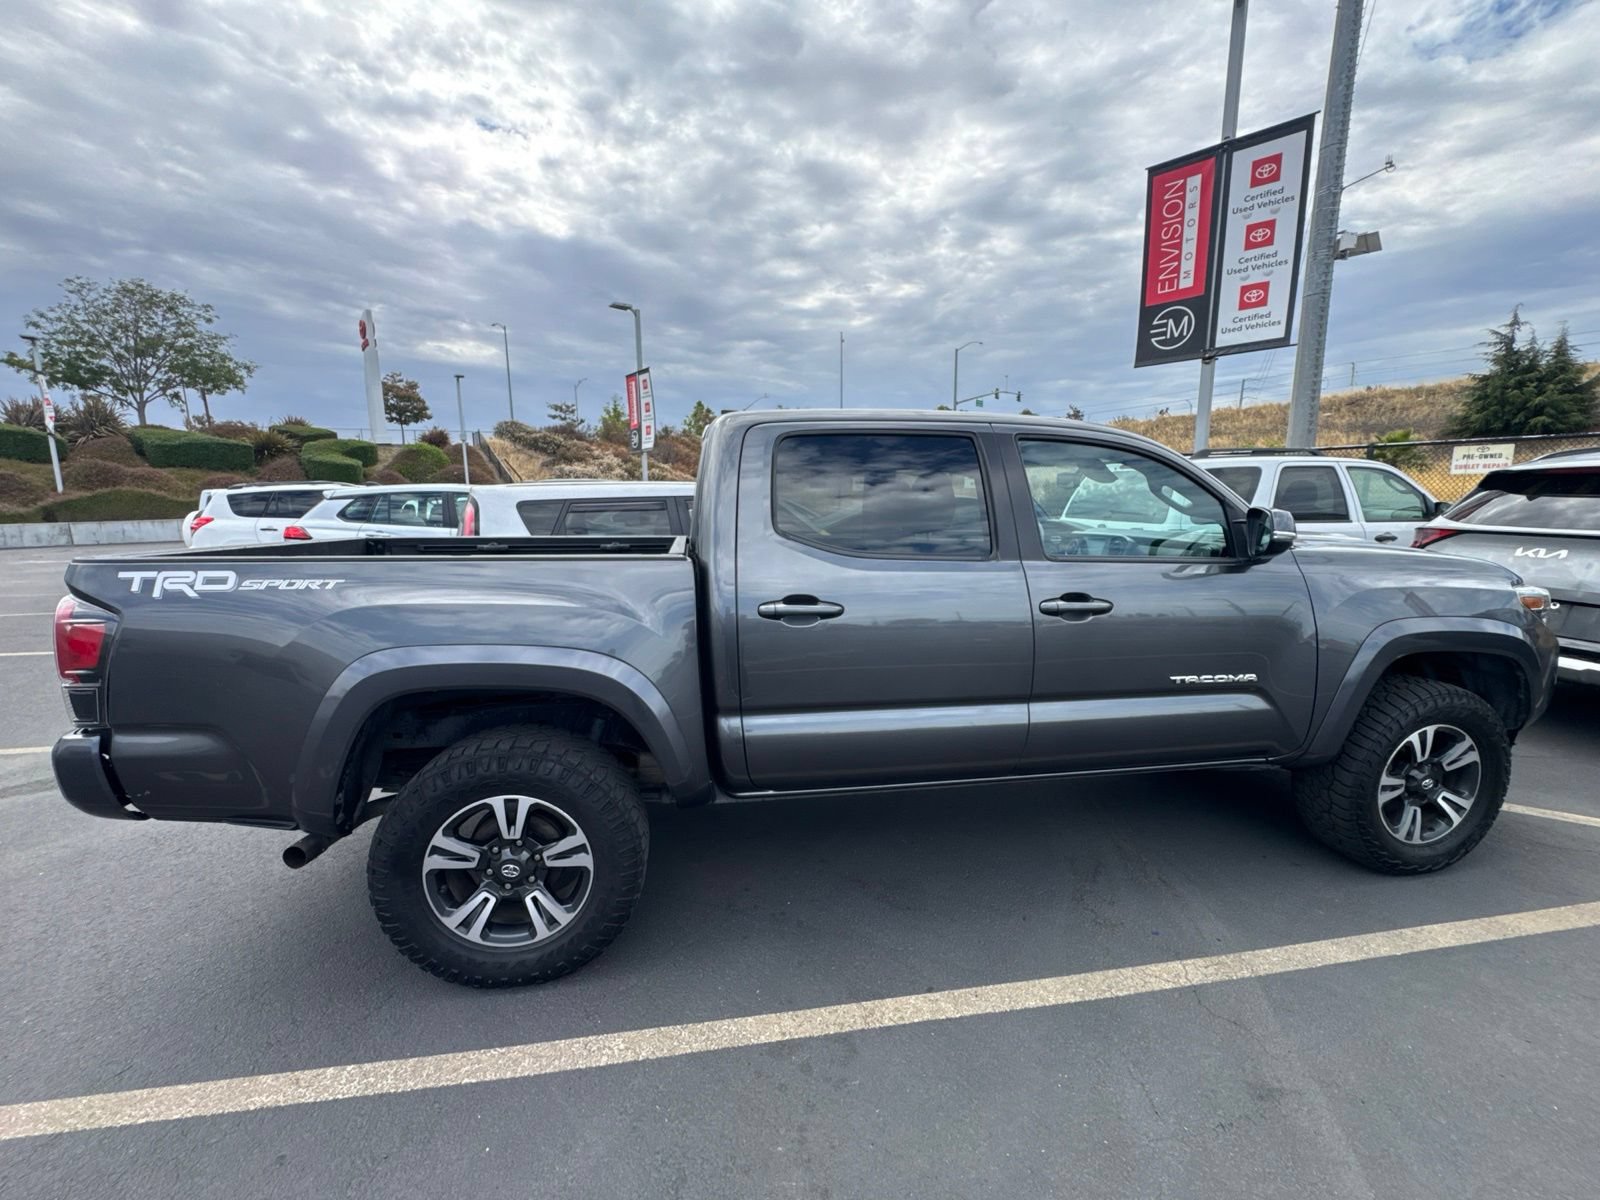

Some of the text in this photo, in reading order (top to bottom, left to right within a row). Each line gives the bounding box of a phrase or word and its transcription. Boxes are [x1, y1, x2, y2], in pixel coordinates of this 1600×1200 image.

[1243, 186, 1285, 203] Certified
[1232, 194, 1296, 215] Used Vehicles
[1157, 178, 1185, 294] ENVISION
[1182, 185, 1199, 280] MOTORS
[1237, 250, 1278, 265] Certified
[1226, 258, 1289, 276] Used Vehicles
[1232, 311, 1272, 324] Certified
[1220, 318, 1282, 335] Used Vehicles
[1514, 547, 1569, 560] KIA
[117, 570, 346, 600] TRD SPORT
[1169, 673, 1258, 684] TACOMA
